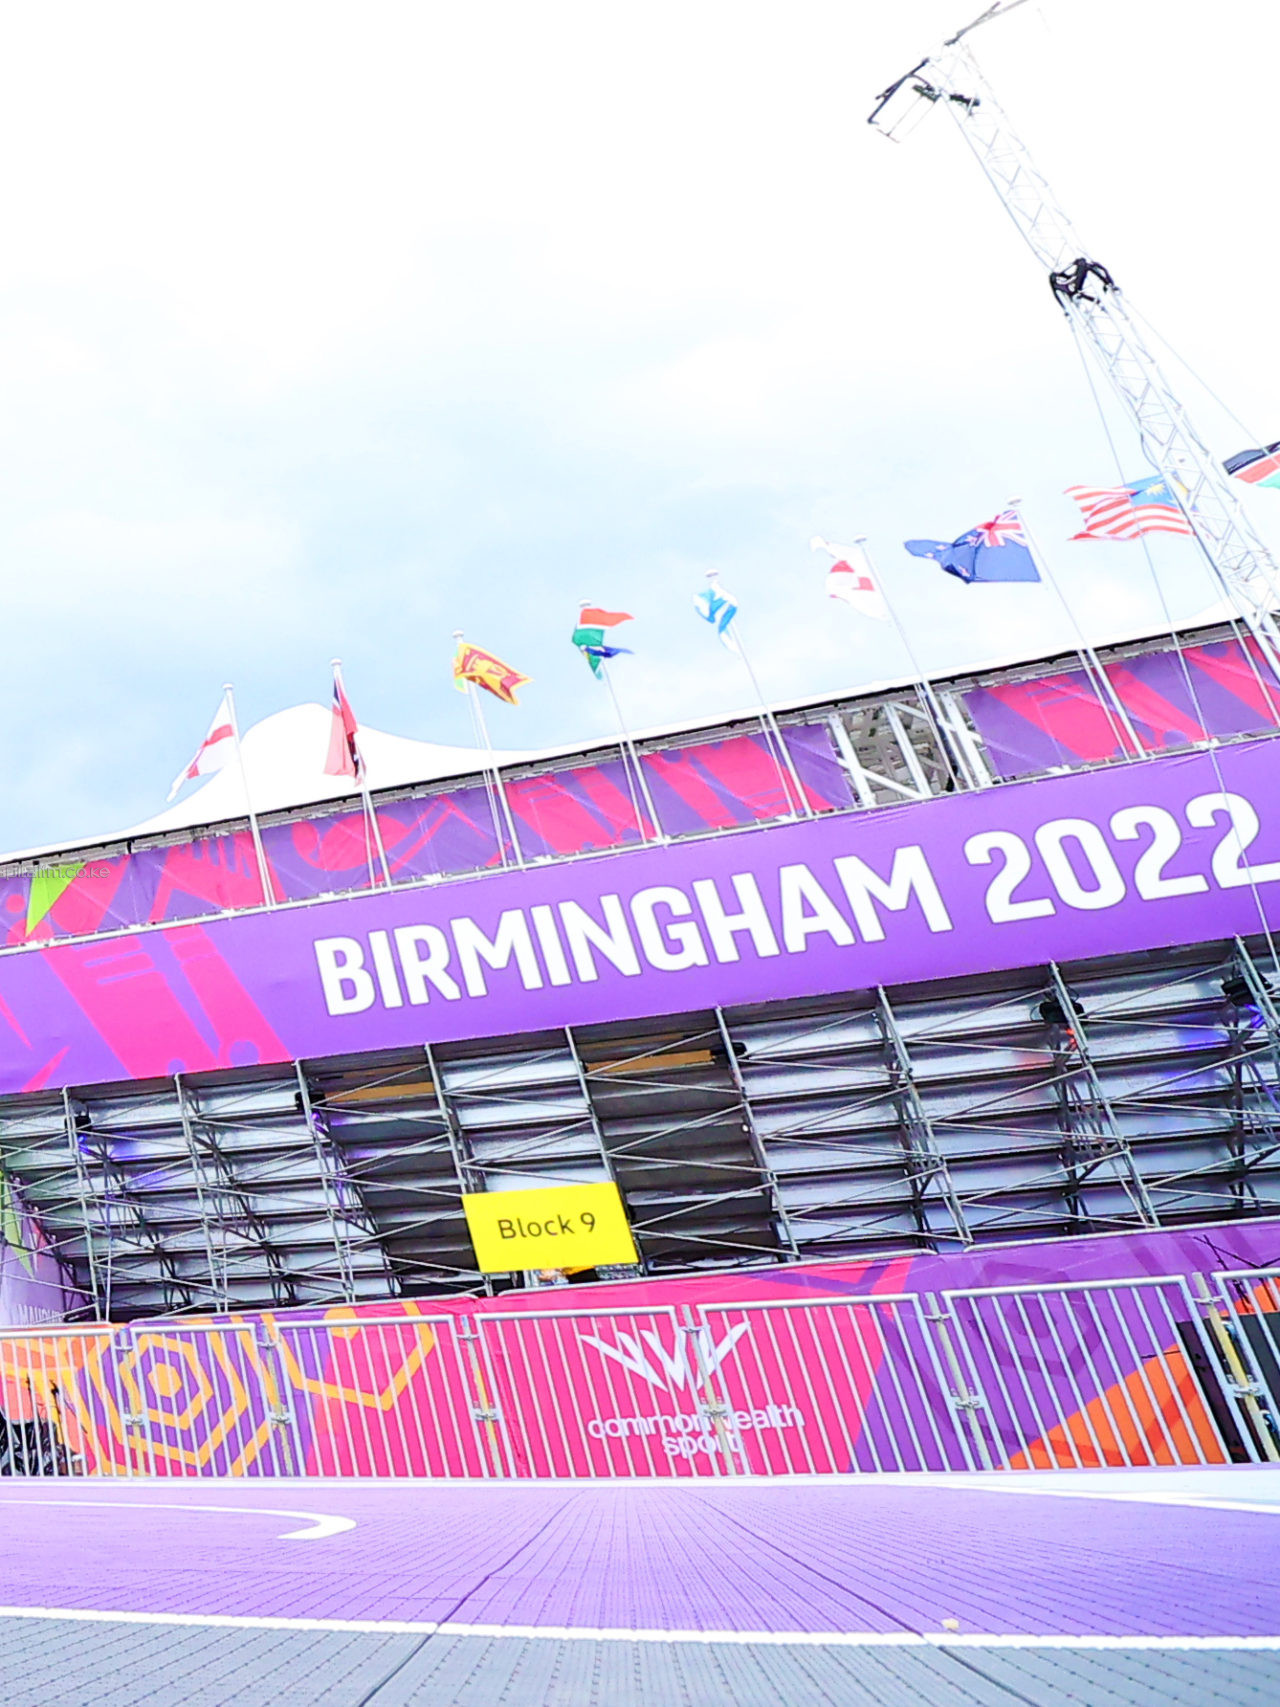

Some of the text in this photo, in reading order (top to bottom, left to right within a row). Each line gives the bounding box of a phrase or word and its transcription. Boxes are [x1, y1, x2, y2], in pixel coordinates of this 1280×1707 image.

[314, 791, 1280, 1017] BIRMINGHAM 2022
[497, 1212, 596, 1239] Block 9
